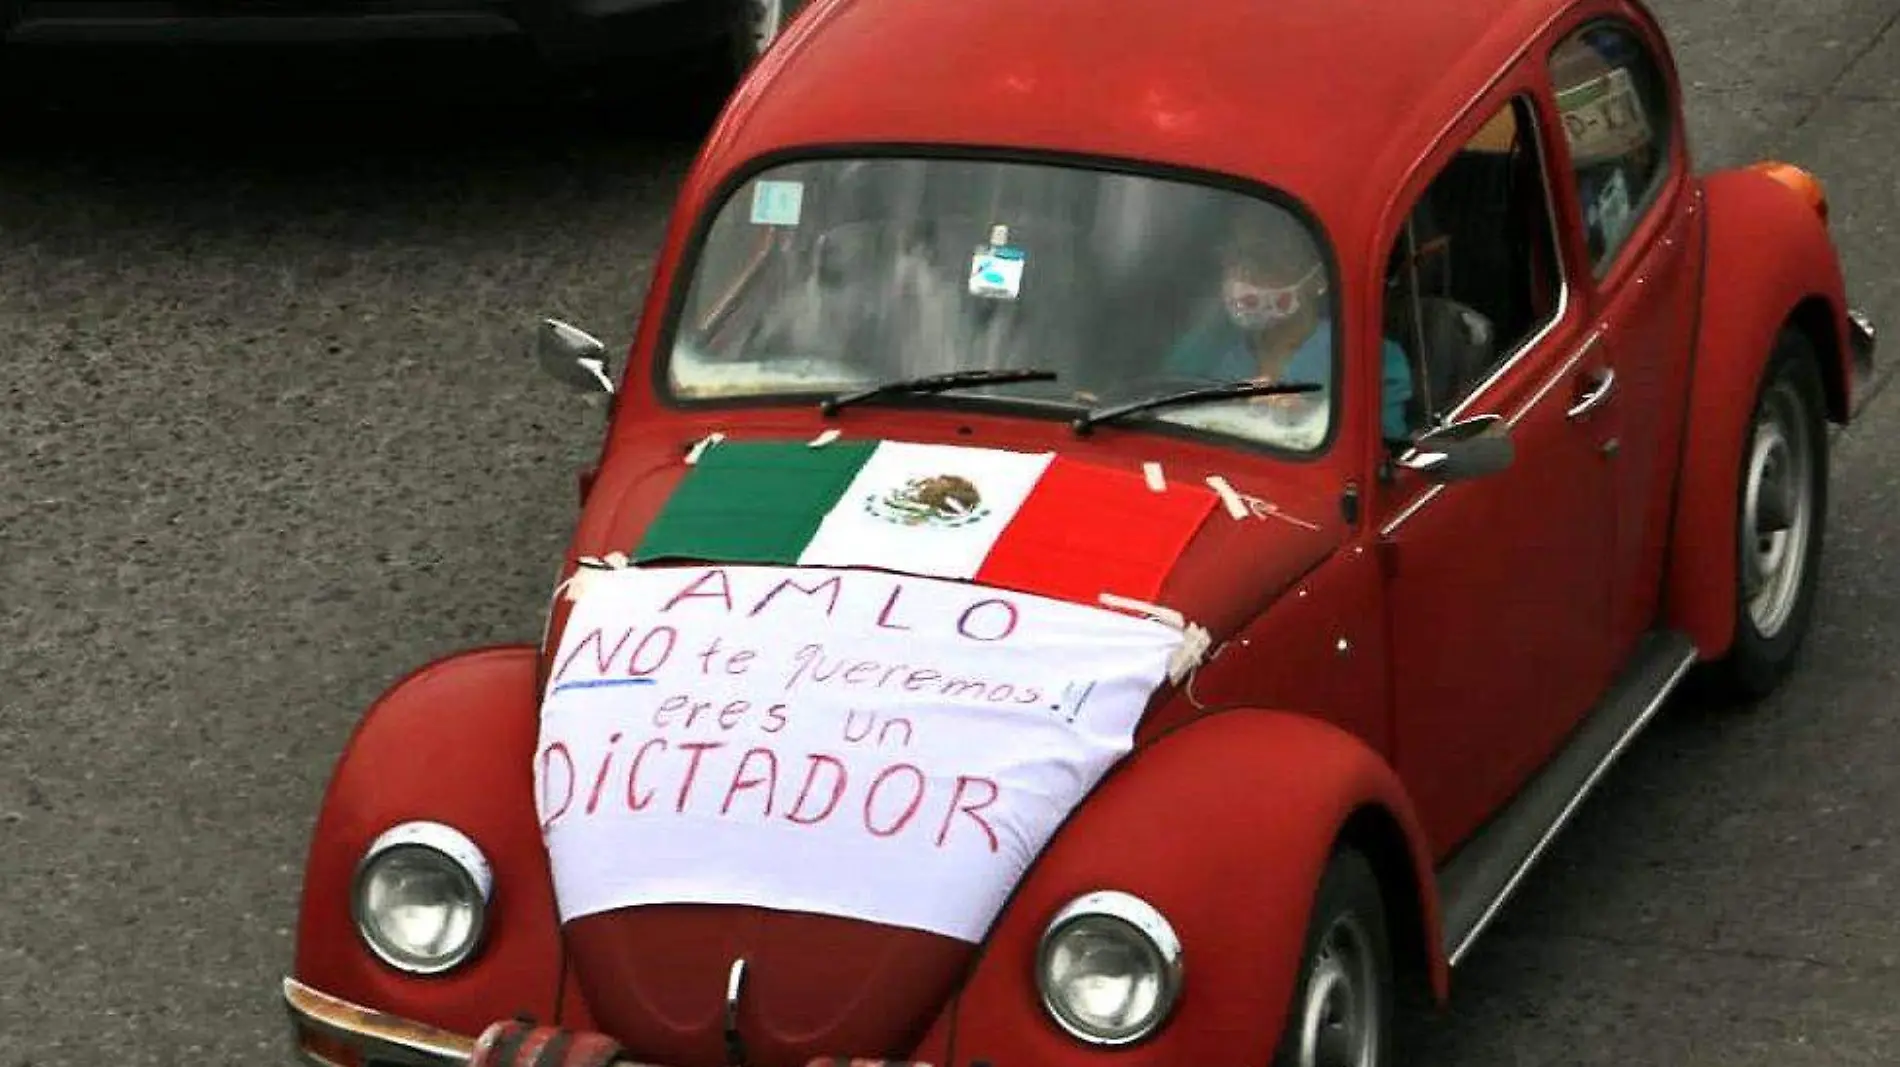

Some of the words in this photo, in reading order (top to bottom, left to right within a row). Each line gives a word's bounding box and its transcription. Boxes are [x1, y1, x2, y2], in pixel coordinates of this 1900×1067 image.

[660, 570, 1020, 641] AMLO
[554, 626, 678, 681] NO
[698, 637, 758, 677] te
[652, 694, 789, 733] eres
[843, 708, 913, 746] un
